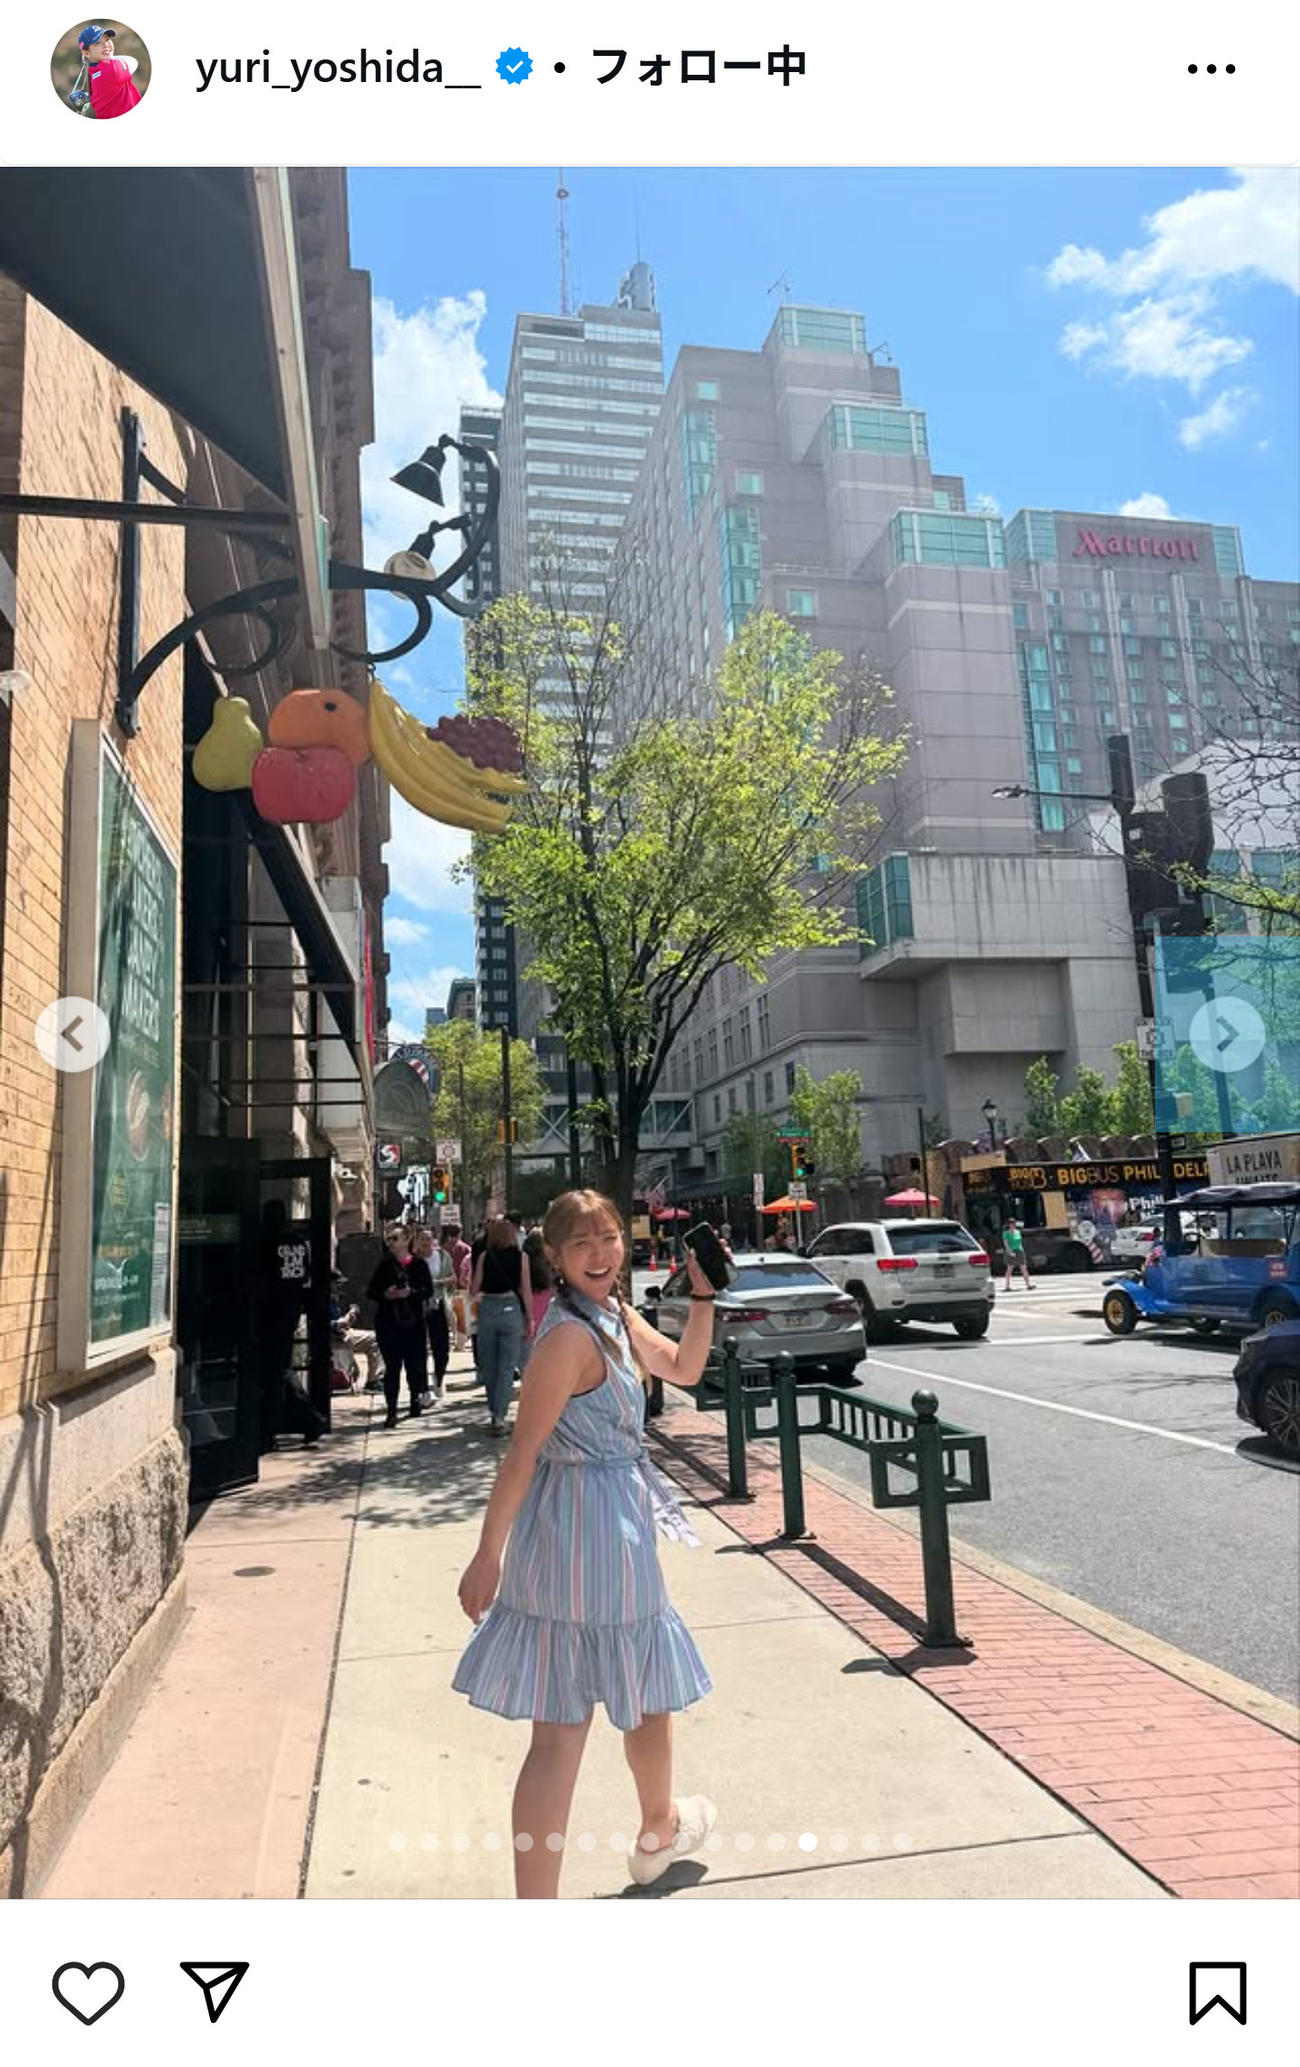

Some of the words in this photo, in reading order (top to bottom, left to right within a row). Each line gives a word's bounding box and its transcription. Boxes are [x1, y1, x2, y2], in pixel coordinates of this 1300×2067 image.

[1072, 529, 1199, 561] Marriott
[1226, 1155, 1241, 1174] LA
[1242, 1150, 1282, 1172] PLAYA
